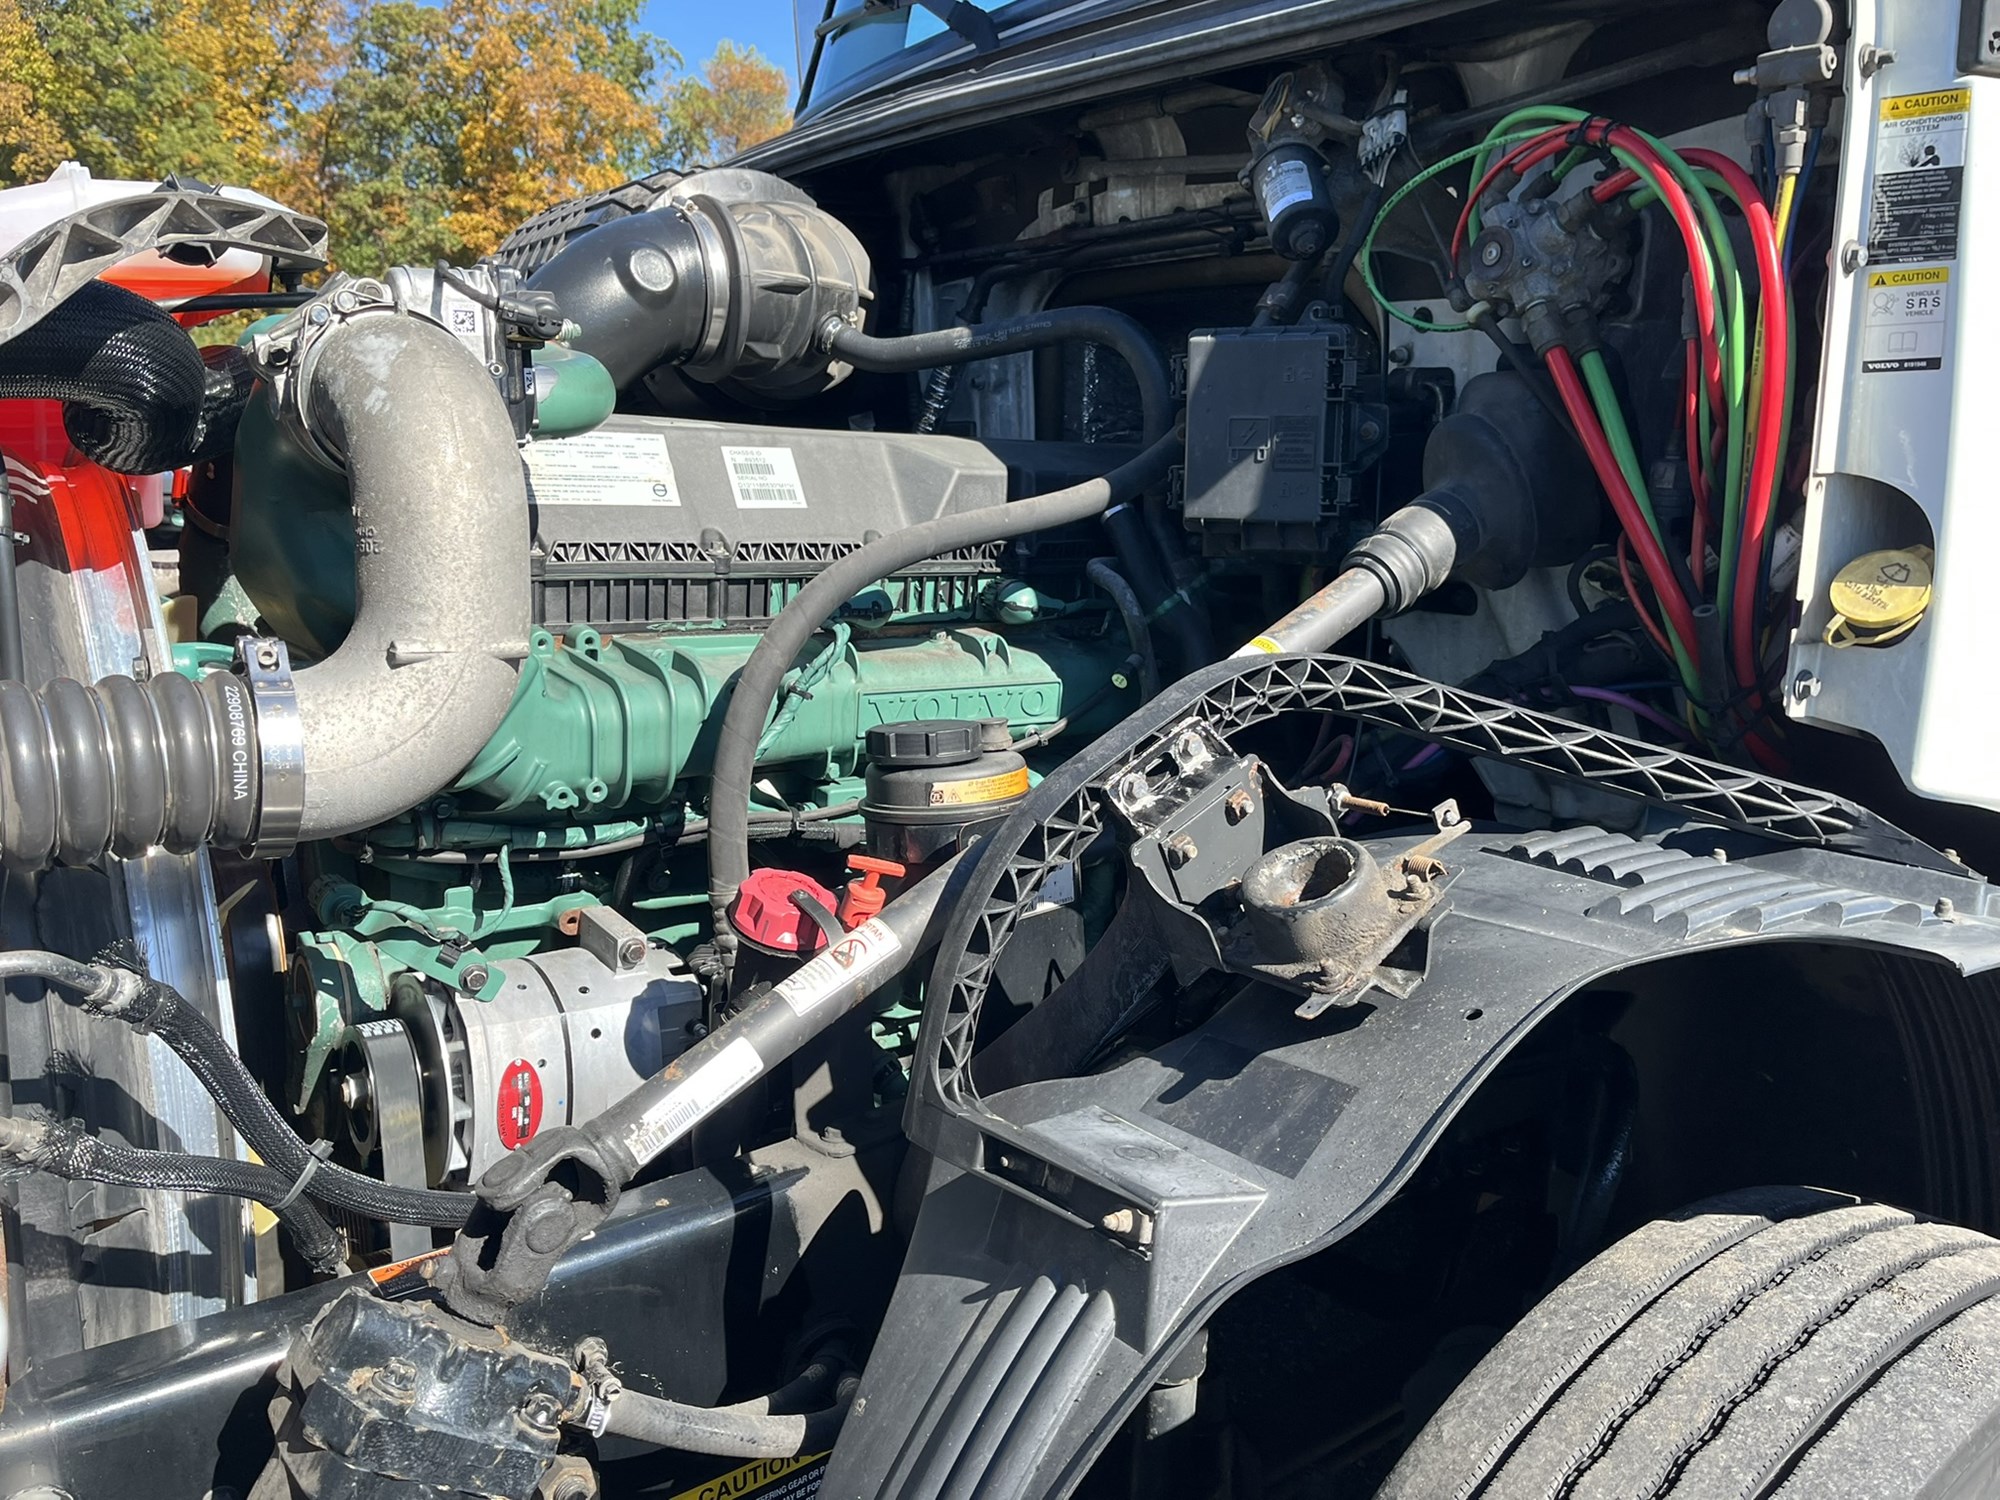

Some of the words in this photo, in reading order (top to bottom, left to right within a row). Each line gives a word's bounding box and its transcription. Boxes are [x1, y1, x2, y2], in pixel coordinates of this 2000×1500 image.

[1904, 94, 1959, 109] CAUTION
[1883, 121, 1897, 129] AIR
[1899, 114, 1962, 127] CONDITIONING
[1905, 124, 1940, 134] SYSTEM
[1892, 271, 1940, 283] CAUTION
[1906, 290, 1940, 298] VEHICULE
[1905, 309, 1934, 317] VEHICLE
[994, 326, 1022, 338] UNITED
[1025, 321, 1052, 330] STATES
[1867, 362, 1900, 370] VOLVO
[868, 690, 1045, 724] VOLVO
[224, 685, 246, 746] 22908769
[232, 750, 248, 800] CHINA
[788, 1475, 808, 1490] GEAR
[808, 1469, 820, 1480] OR
[796, 1487, 806, 1499] BE
